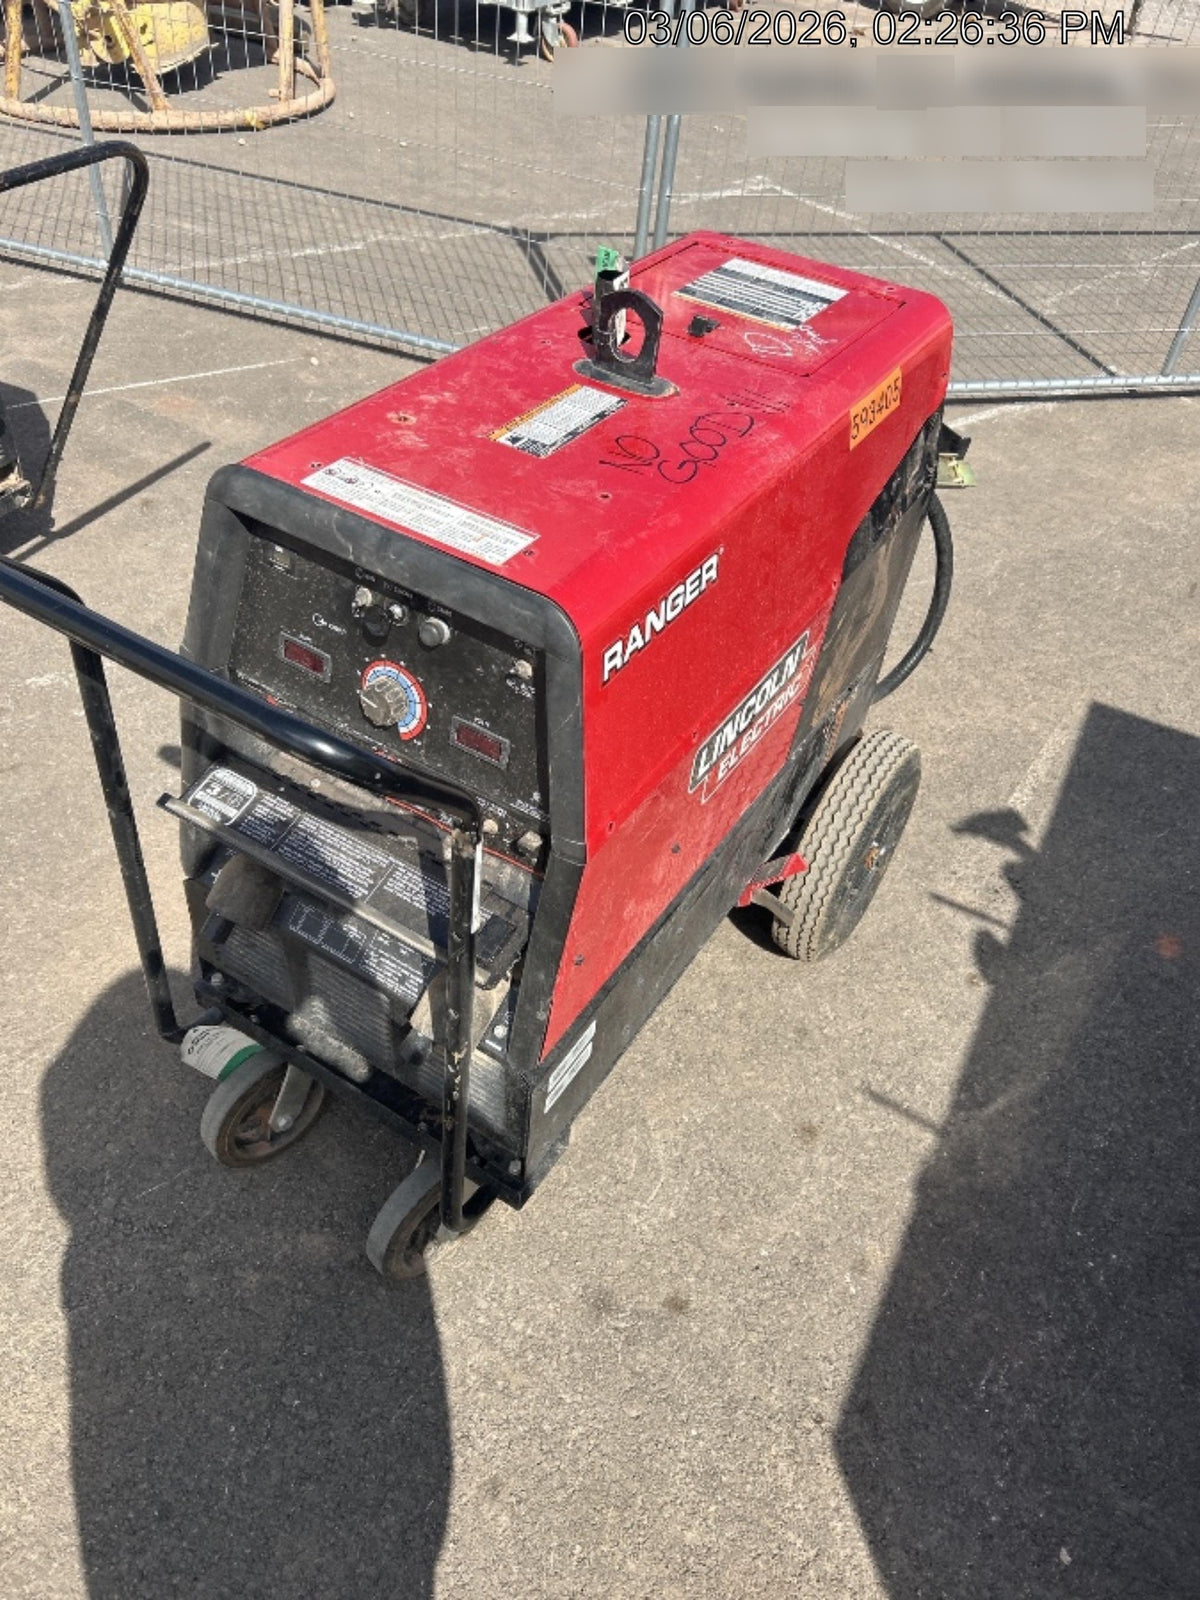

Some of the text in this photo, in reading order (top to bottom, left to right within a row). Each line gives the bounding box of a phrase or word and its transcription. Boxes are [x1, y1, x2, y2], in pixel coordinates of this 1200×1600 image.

[598, 434, 660, 475] NO
[657, 412, 755, 484] GOOD
[602, 553, 720, 684] RANGER
[696, 643, 803, 779] LINCOLN
[717, 676, 802, 781] ELECTRIC
